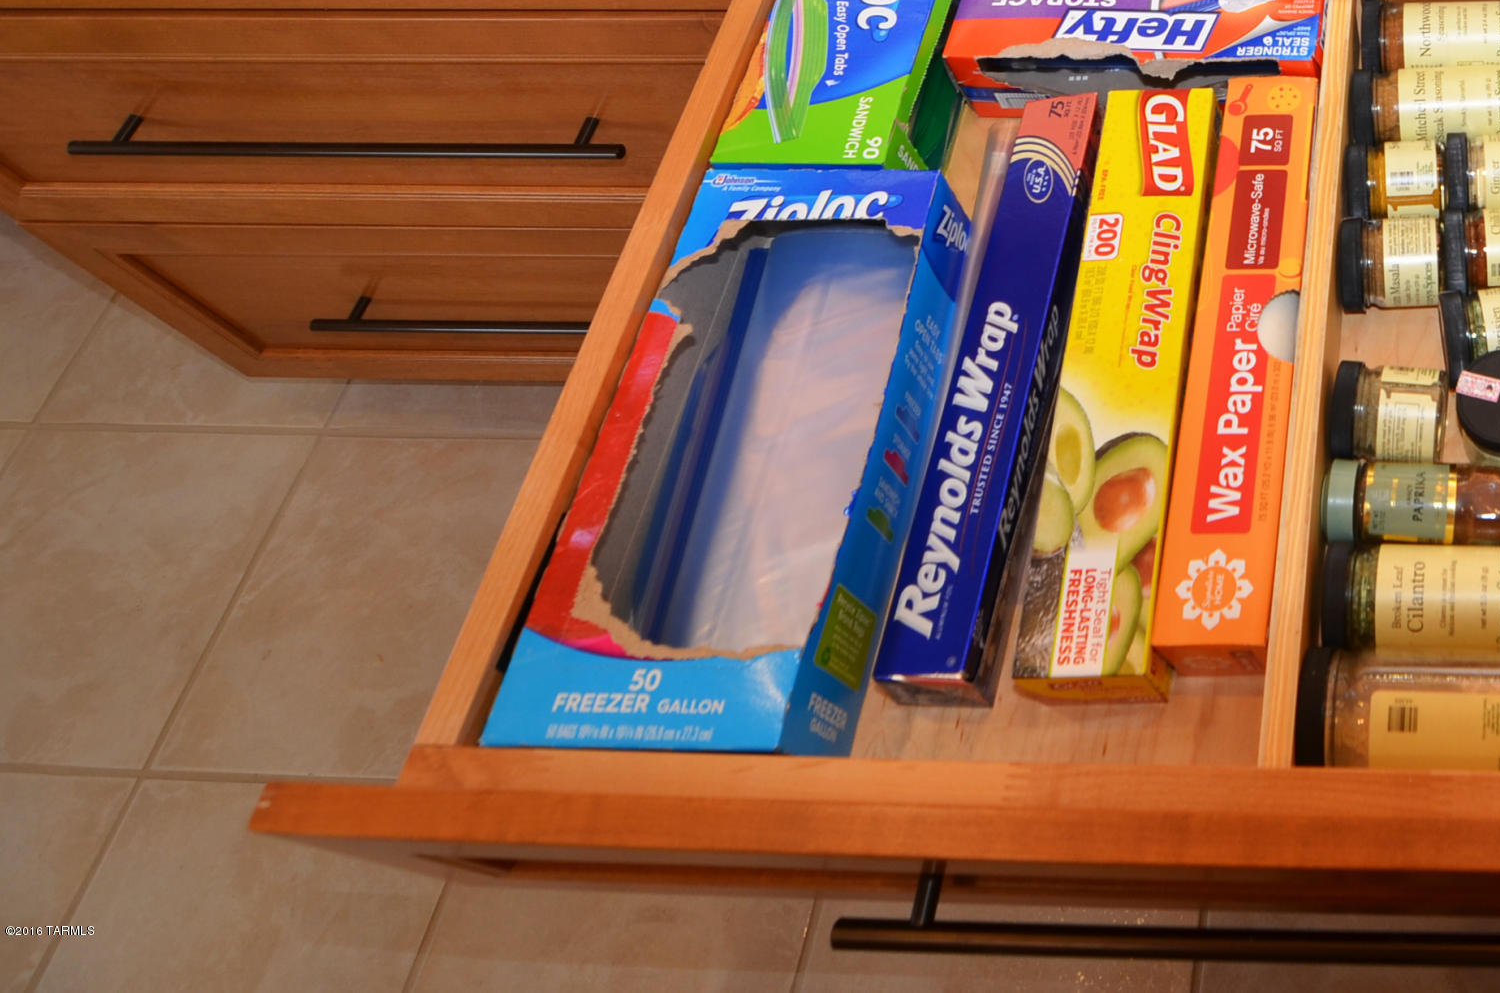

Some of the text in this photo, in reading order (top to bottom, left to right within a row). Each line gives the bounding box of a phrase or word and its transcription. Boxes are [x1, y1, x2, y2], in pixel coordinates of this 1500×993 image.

[833, 0, 849, 76] Easy Open Tabs
[1062, 9, 1207, 46] Hefty
[1236, 45, 1309, 56] STRONGER
[1274, 36, 1310, 47] SEAL
[1420, 2, 1432, 57] Nothwoo
[842, 95, 874, 159] SANDWICH
[1049, 100, 1066, 119] 75
[1412, 71, 1428, 141] Mitchel Street
[1431, 71, 1446, 142] Steak Sasoning
[862, 136, 883, 160] 90
[1144, 93, 1186, 192] GLAD
[1250, 127, 1275, 154] 75
[1273, 129, 1285, 152] SQ FT
[1093, 216, 1120, 258] 200
[1243, 173, 1265, 265] Microwave-Safe
[1389, 263, 1401, 295] Masala
[1422, 261, 1435, 289] Spices
[1226, 287, 1246, 332] Papier
[1245, 302, 1263, 332] Ciré
[970, 382, 1014, 515] TRUSTED SINCE 1947
[1000, 305, 1061, 546] Reynolds Wrap
[1206, 337, 1263, 523] Wax Paper
[894, 412, 984, 641] Reynolds
[951, 301, 1019, 410] Wrap
[1411, 471, 1427, 523] PAPRIKA
[1213, 573, 1226, 606] HOME
[1391, 565, 1405, 630] Broken Leaf
[1405, 560, 1427, 633] Cilantro
[1056, 568, 1083, 667] FRESHNESS
[1073, 568, 1098, 666] LONG-LASTING
[1091, 567, 1112, 664] Tight Seal for
[551, 692, 726, 716] FREEZER GALLON
[628, 669, 663, 692] 50
[808, 691, 849, 731] FREEZER
[810, 717, 839, 743] GALLON
